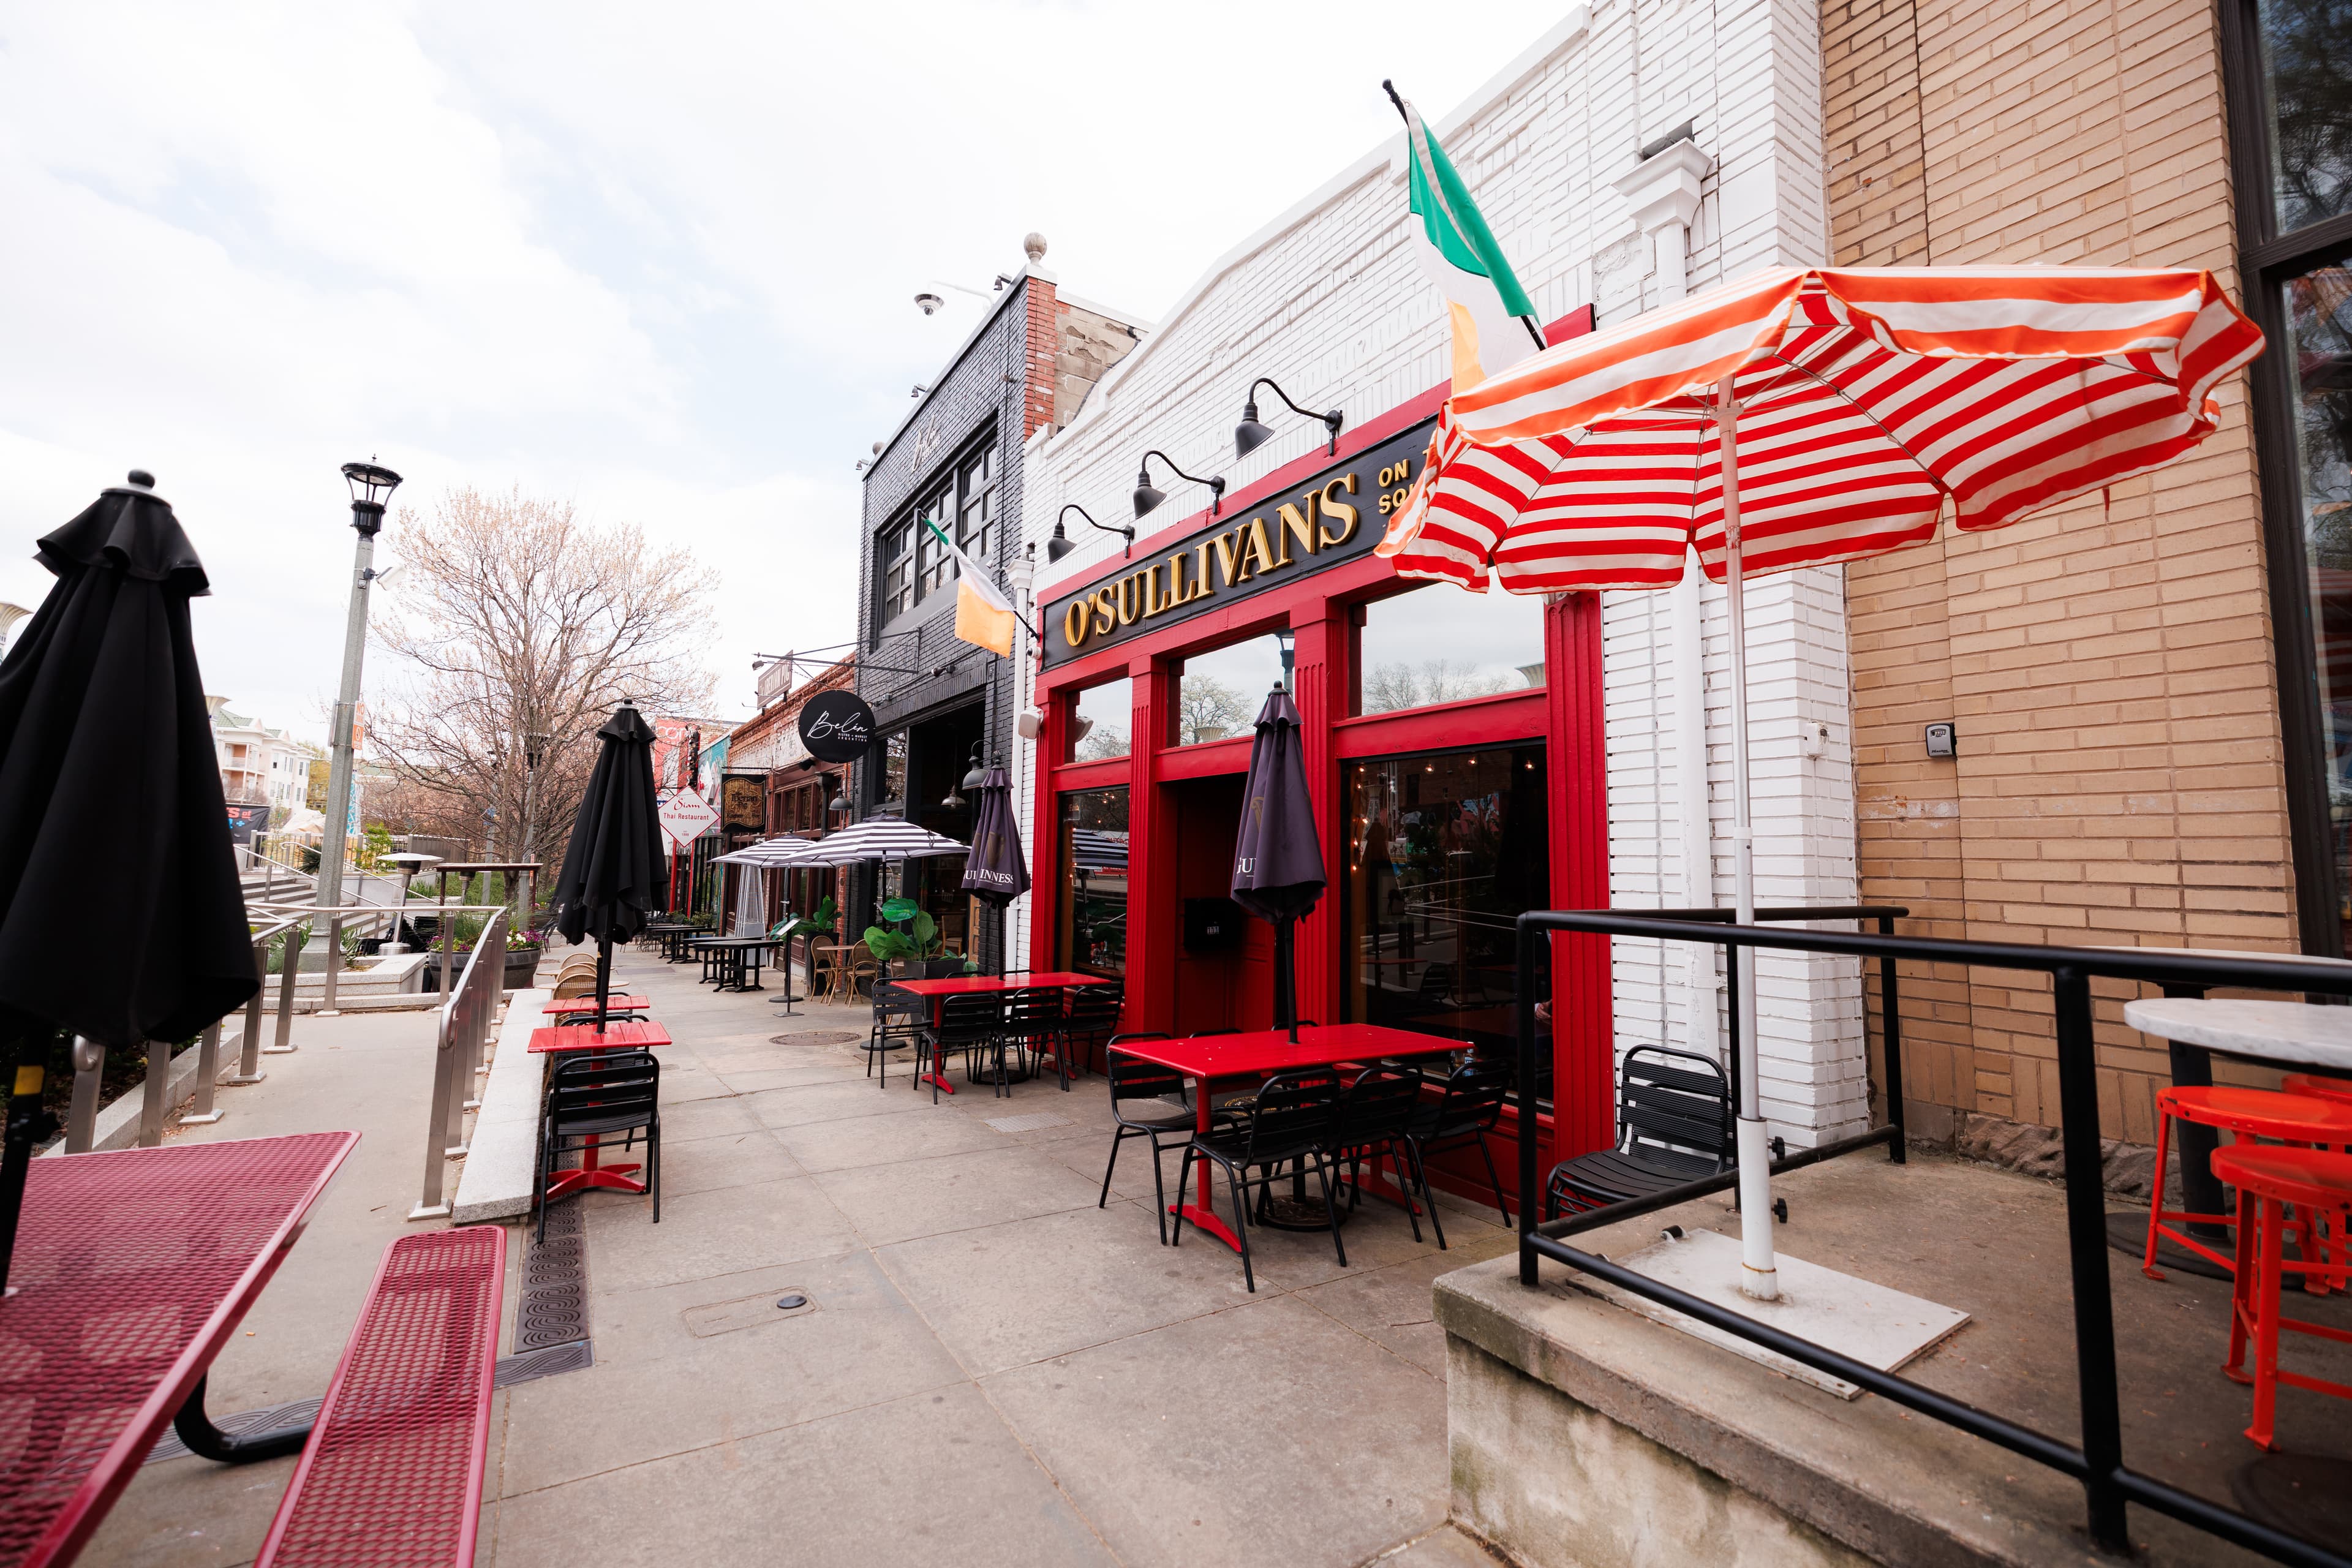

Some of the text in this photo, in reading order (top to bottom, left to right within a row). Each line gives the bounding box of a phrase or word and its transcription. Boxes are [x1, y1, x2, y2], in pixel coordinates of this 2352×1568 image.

[1065, 459, 1409, 647] O'SULLIVANS ON
[356, 703, 365, 715] NO
[674, 798, 700, 810] Siam
